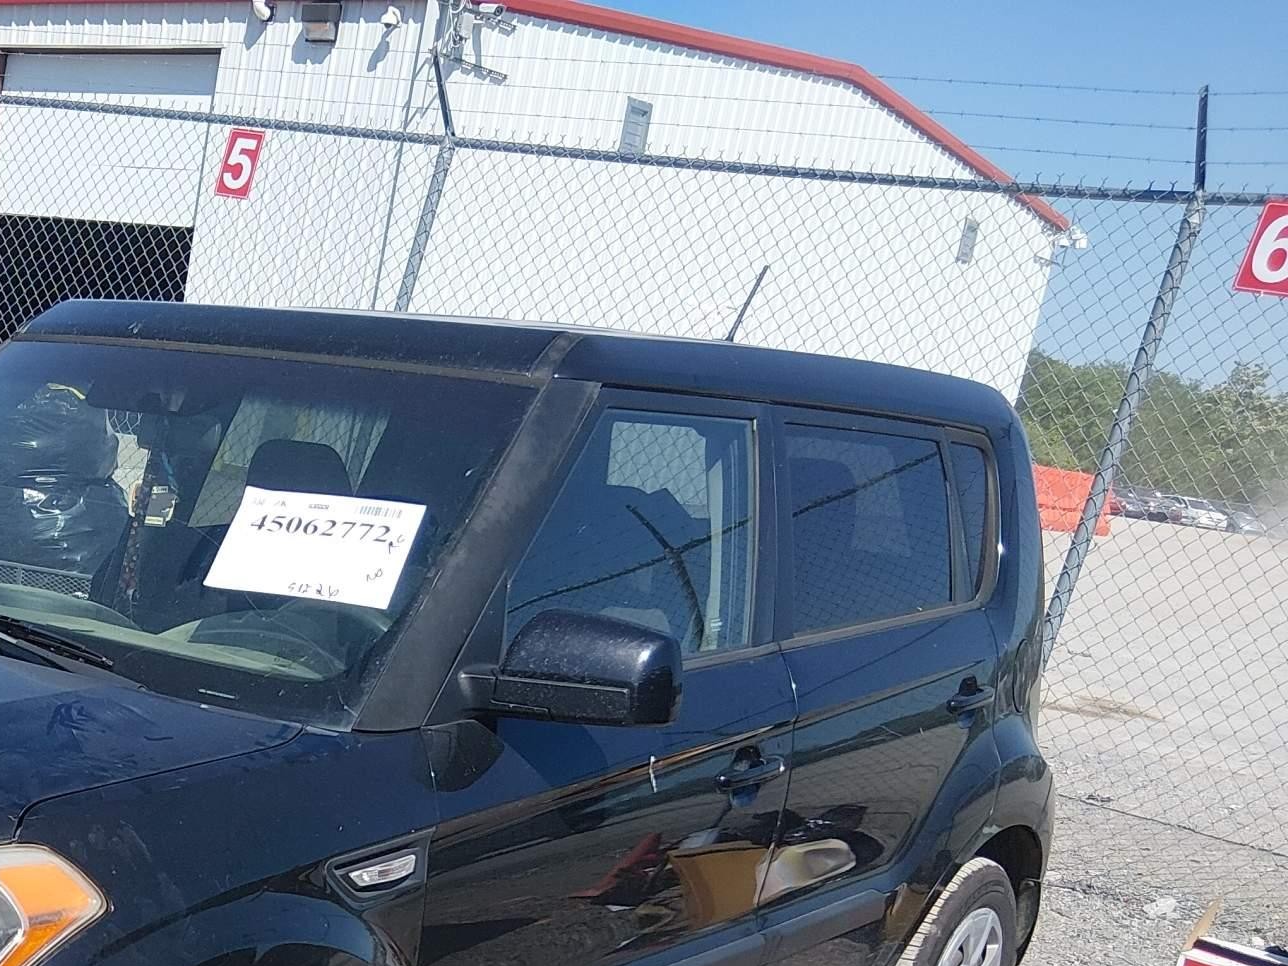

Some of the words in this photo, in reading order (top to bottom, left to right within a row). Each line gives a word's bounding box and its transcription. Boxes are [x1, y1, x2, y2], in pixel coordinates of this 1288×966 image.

[223, 137, 258, 190] 5
[1252, 214, 1288, 284] 6
[250, 514, 391, 543] 45062772
